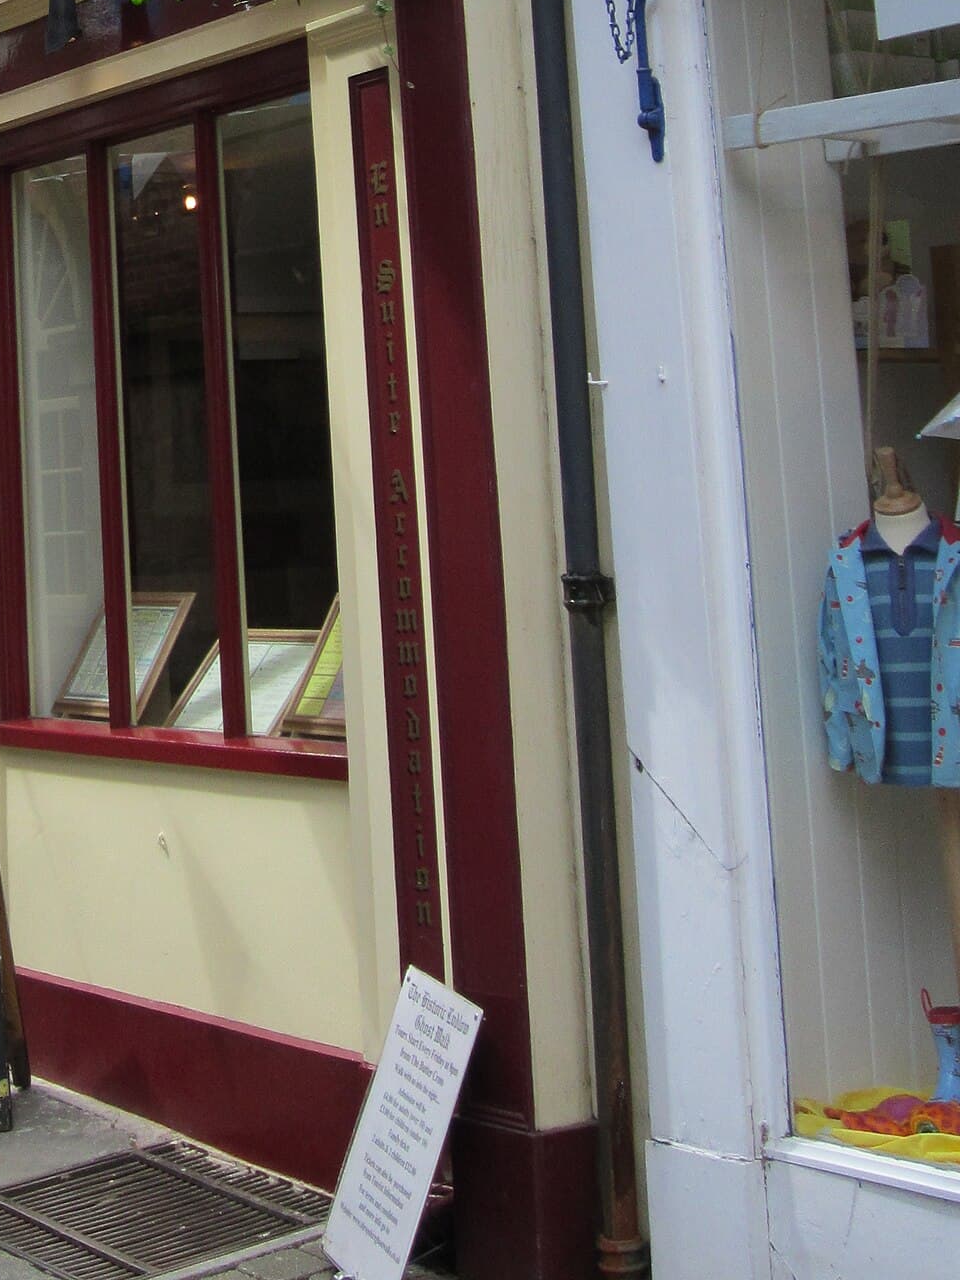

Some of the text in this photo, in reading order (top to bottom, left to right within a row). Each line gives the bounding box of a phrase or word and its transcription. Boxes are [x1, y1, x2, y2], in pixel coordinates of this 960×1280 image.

[370, 160, 390, 228] En
[376, 259, 401, 435] Suite
[413, 1011, 436, 1040] Ghost
